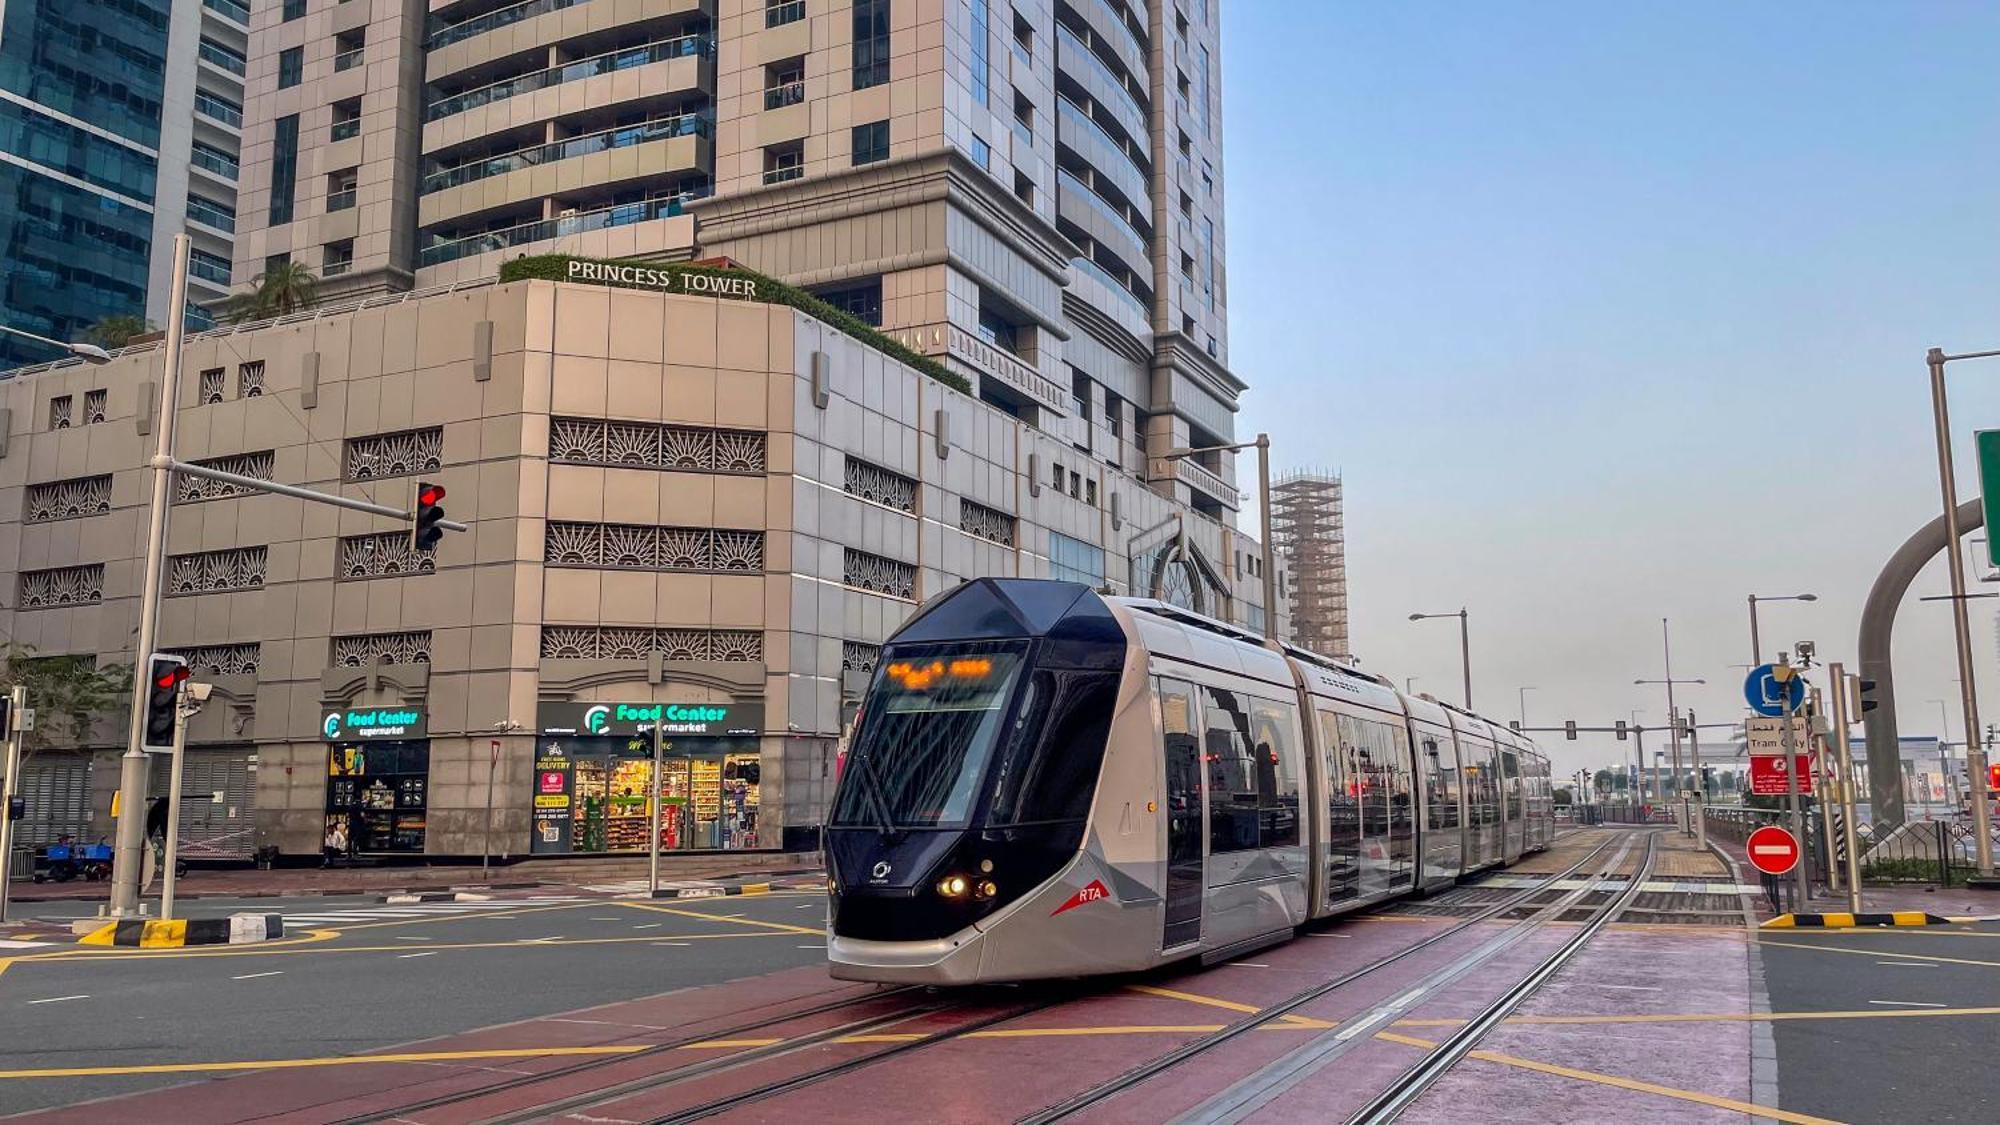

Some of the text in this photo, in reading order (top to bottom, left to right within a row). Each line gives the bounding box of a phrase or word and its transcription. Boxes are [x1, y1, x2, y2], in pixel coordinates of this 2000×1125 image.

[568, 260, 756, 297] PRINCESS TOWER
[347, 711, 418, 726] Food Center
[616, 704, 727, 721] Food Center
[359, 726, 404, 736] supermarket
[1751, 739, 1805, 749] Tram Oly
[1079, 887, 1101, 902] RTA
